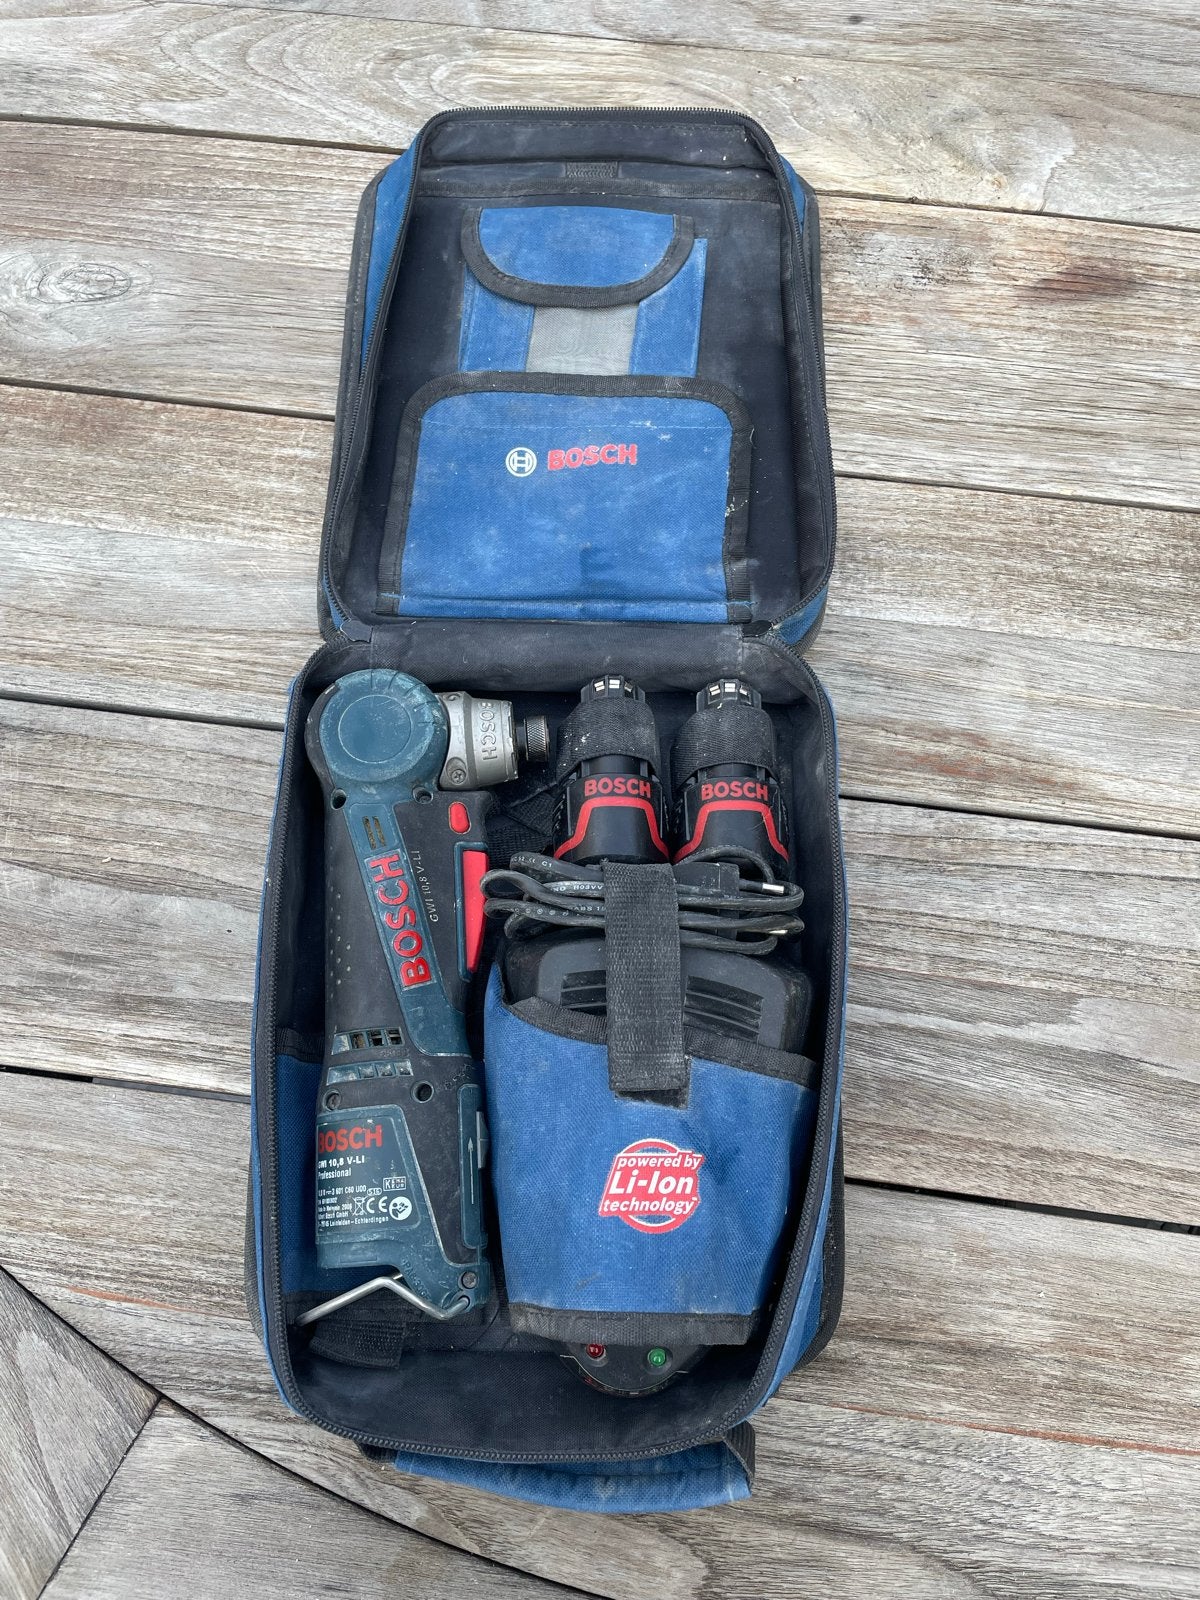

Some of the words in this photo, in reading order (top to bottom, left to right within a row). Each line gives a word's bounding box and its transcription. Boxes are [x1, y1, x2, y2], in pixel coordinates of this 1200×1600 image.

[547, 443, 638, 471] BOSCH
[480, 702, 498, 760] BOSCH
[584, 776, 651, 798] BOSCH
[701, 780, 769, 801] BOSCH
[410, 850, 425, 874] V-LI
[418, 876, 431, 895] 10,8
[369, 853, 432, 987] BOSCH
[424, 898, 439, 922] GWI
[318, 1124, 383, 1154] BOSCH
[328, 1157, 344, 1169] 10,8
[346, 1155, 365, 1165] V-LI
[616, 1155, 682, 1169] powered
[683, 1154, 701, 1170] by
[608, 1169, 694, 1195] Li-Ion
[603, 1198, 694, 1215] technology
